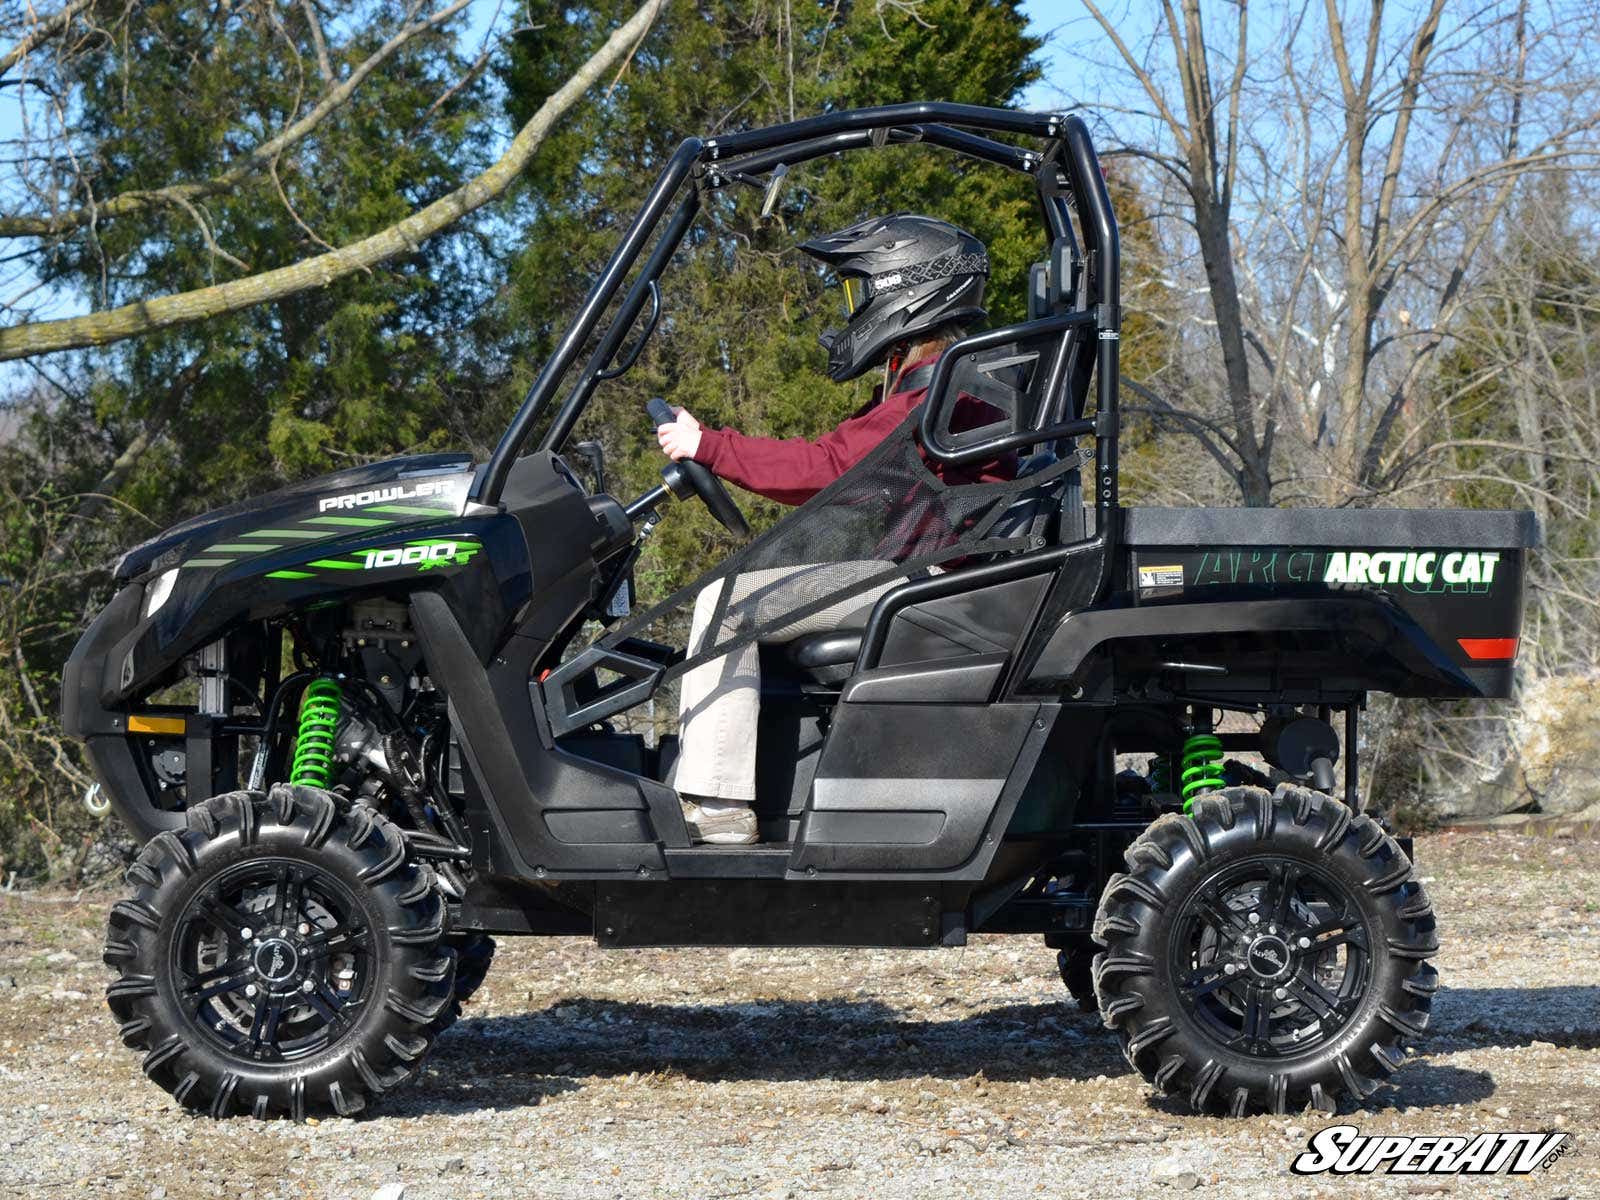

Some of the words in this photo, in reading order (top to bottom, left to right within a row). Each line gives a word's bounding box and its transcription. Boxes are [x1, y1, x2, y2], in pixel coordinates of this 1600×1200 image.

[319, 479, 456, 512] PROWLER
[364, 541, 458, 570] 1000
[1323, 551, 1436, 584] ARCTIC
[1441, 551, 1501, 584] CAT
